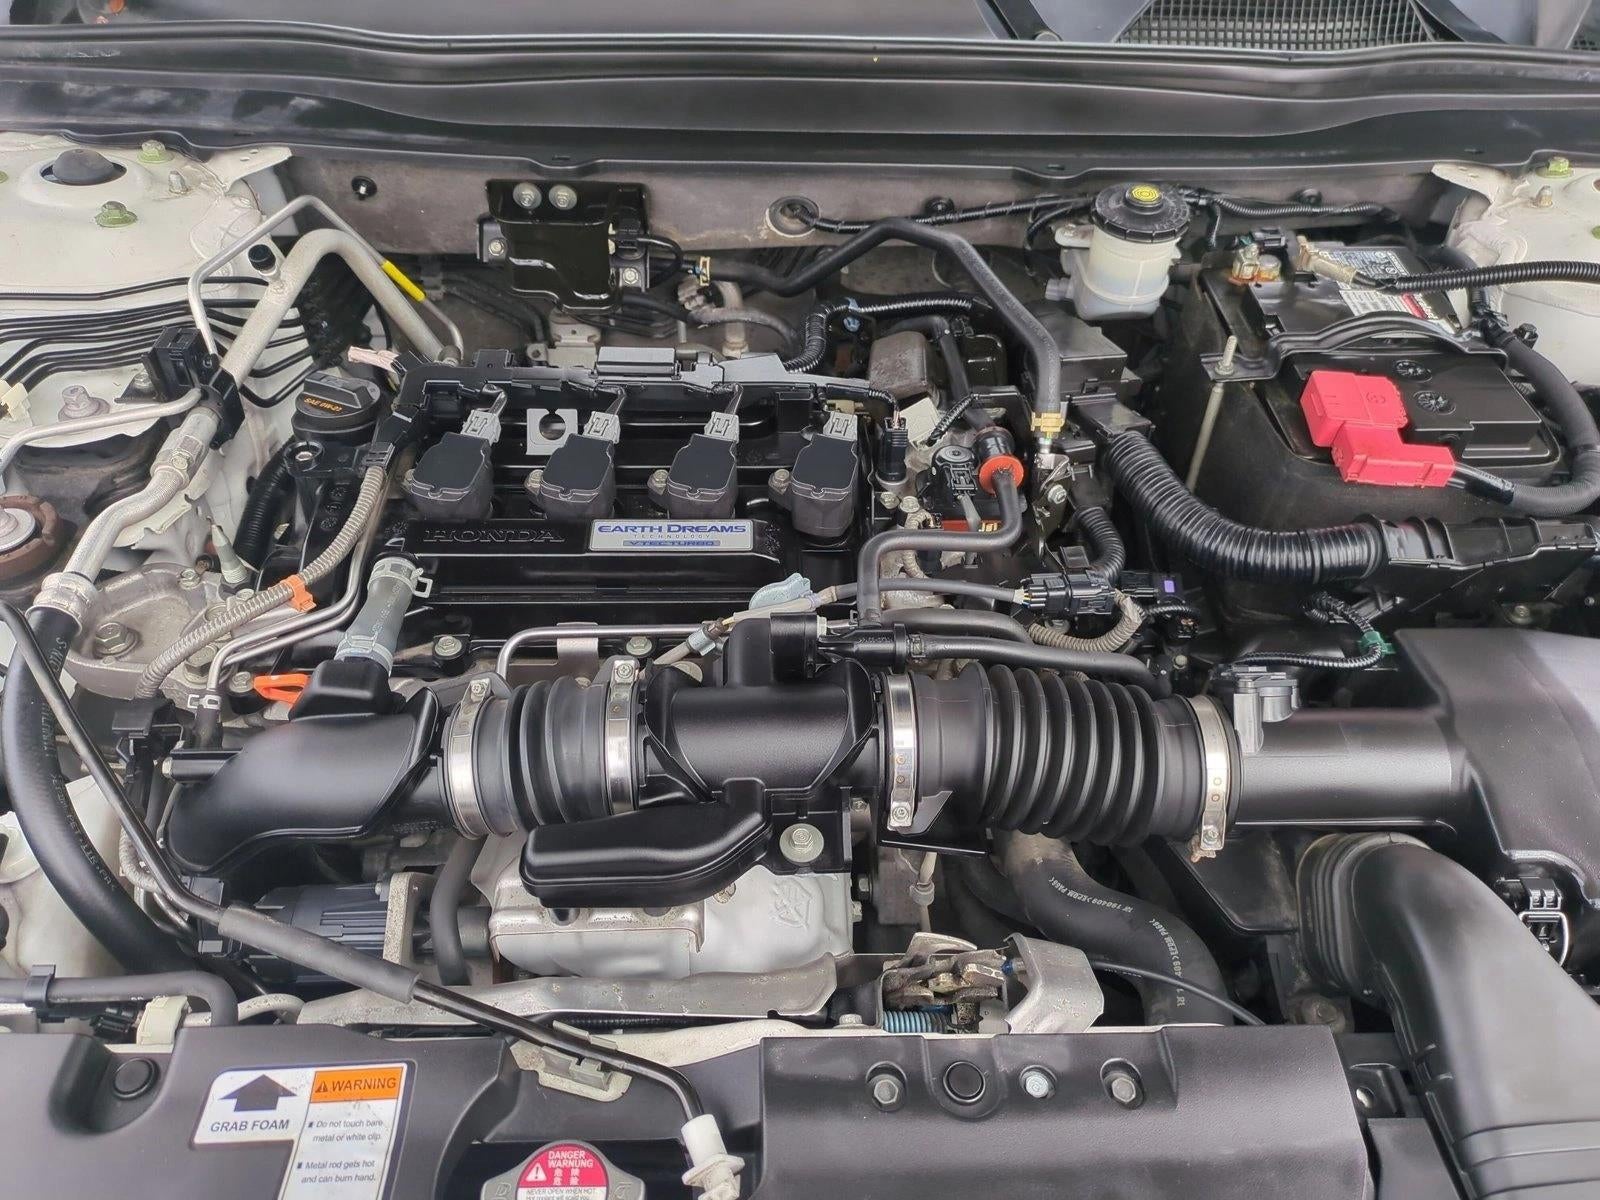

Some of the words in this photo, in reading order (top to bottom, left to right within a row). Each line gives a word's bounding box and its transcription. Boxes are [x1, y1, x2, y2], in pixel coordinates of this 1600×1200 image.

[598, 525, 663, 533] EARTH
[667, 524, 746, 533] DREAMS
[423, 530, 565, 542] HONDA
[332, 1077, 397, 1092] WARNING
[210, 1121, 248, 1132] GRAB
[250, 1119, 290, 1131] FOAM
[316, 1120, 327, 1128] Do
[329, 1120, 341, 1128] not
[343, 1120, 364, 1128] touch
[366, 1119, 383, 1127] bare
[312, 1134, 335, 1142] metal
[548, 1151, 586, 1159] DANGER
[305, 1161, 327, 1169] Metal
[343, 1160, 360, 1170] gets
[362, 1160, 376, 1168] hot
[548, 1159, 594, 1168] WARNUNG
[301, 1175, 317, 1183] and
[335, 1174, 353, 1182] burn
[354, 1174, 376, 1182] hand.
